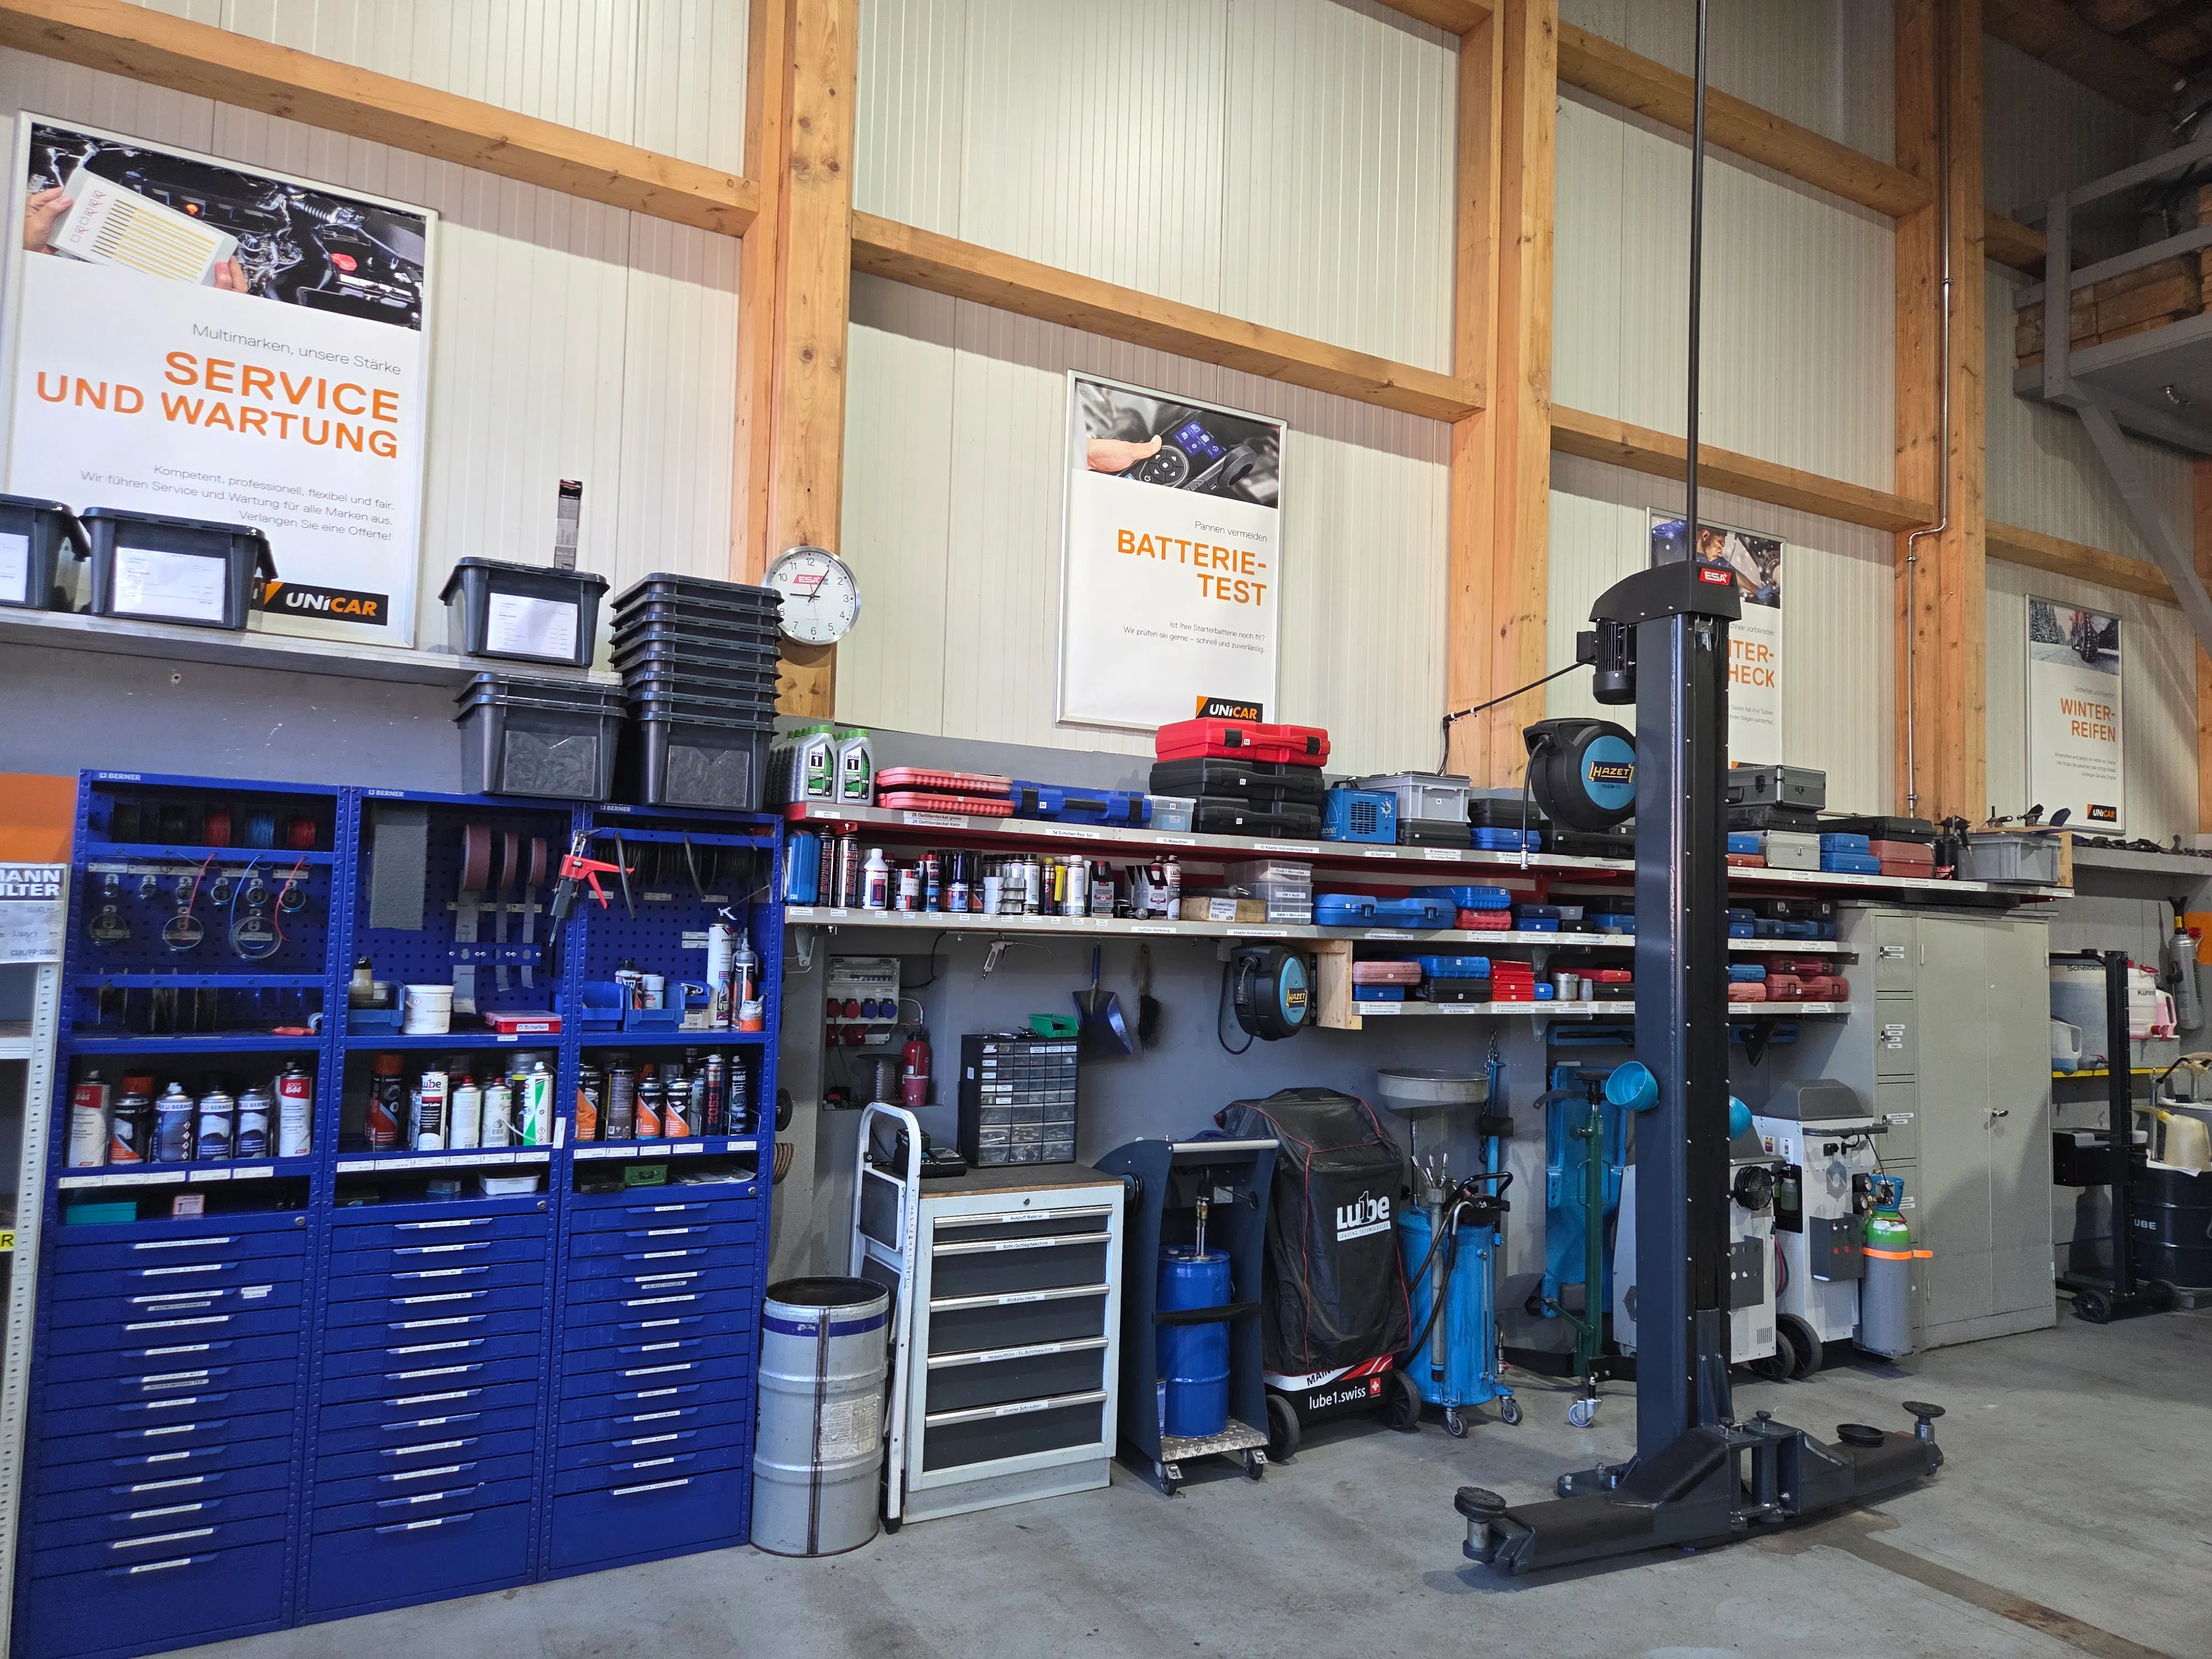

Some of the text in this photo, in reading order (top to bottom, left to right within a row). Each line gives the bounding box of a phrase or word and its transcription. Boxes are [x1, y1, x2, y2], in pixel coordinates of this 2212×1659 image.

[192, 323, 401, 375] Multimarken, unsere Stärke
[164, 351, 399, 424] SERVICE
[37, 371, 398, 459] UND WARTUNG
[154, 465, 394, 510] Kompetent, professionell, flexibel und fair.
[81, 470, 393, 525] Wir führen Service und Wartung für alle Marken aus.
[239, 510, 392, 541] Verlangen Sie eine Offerte!
[1195, 521, 1267, 542] Pannen vermeiden
[1118, 529, 1266, 576] BATTERIE-
[790, 562, 797, 570] 11
[806, 557, 815, 566] 12
[778, 573, 843, 585] 10 2
[1704, 571, 1726, 583] ESA
[1197, 573, 1267, 606] TEST
[843, 594, 849, 603] 3
[780, 608, 785, 616] 8
[793, 621, 833, 631] 7 5
[811, 627, 817, 635] 6
[1193, 624, 1238, 637] Starterbatterie
[1239, 632, 1254, 640] noch
[1137, 628, 1157, 638] prüfen
[1196, 637, 1217, 646] schnell
[1729, 664, 1774, 688] HECK
[2060, 698, 2115, 721] WINTER-
[2072, 720, 2116, 742] REIFEN
[814, 757, 819, 766] 1
[850, 760, 855, 770] 1
[108, 772, 141, 781] BERNER
[1593, 766, 1629, 776] HAZET
[846, 860, 855, 894] 2010
[0, 884, 59, 896] ILTER
[1288, 993, 1306, 1003] HAZET
[1339, 1223, 1389, 1240] LEADING TECHNOLOGIES
[1309, 1386, 1366, 1410] lube1.swiss
